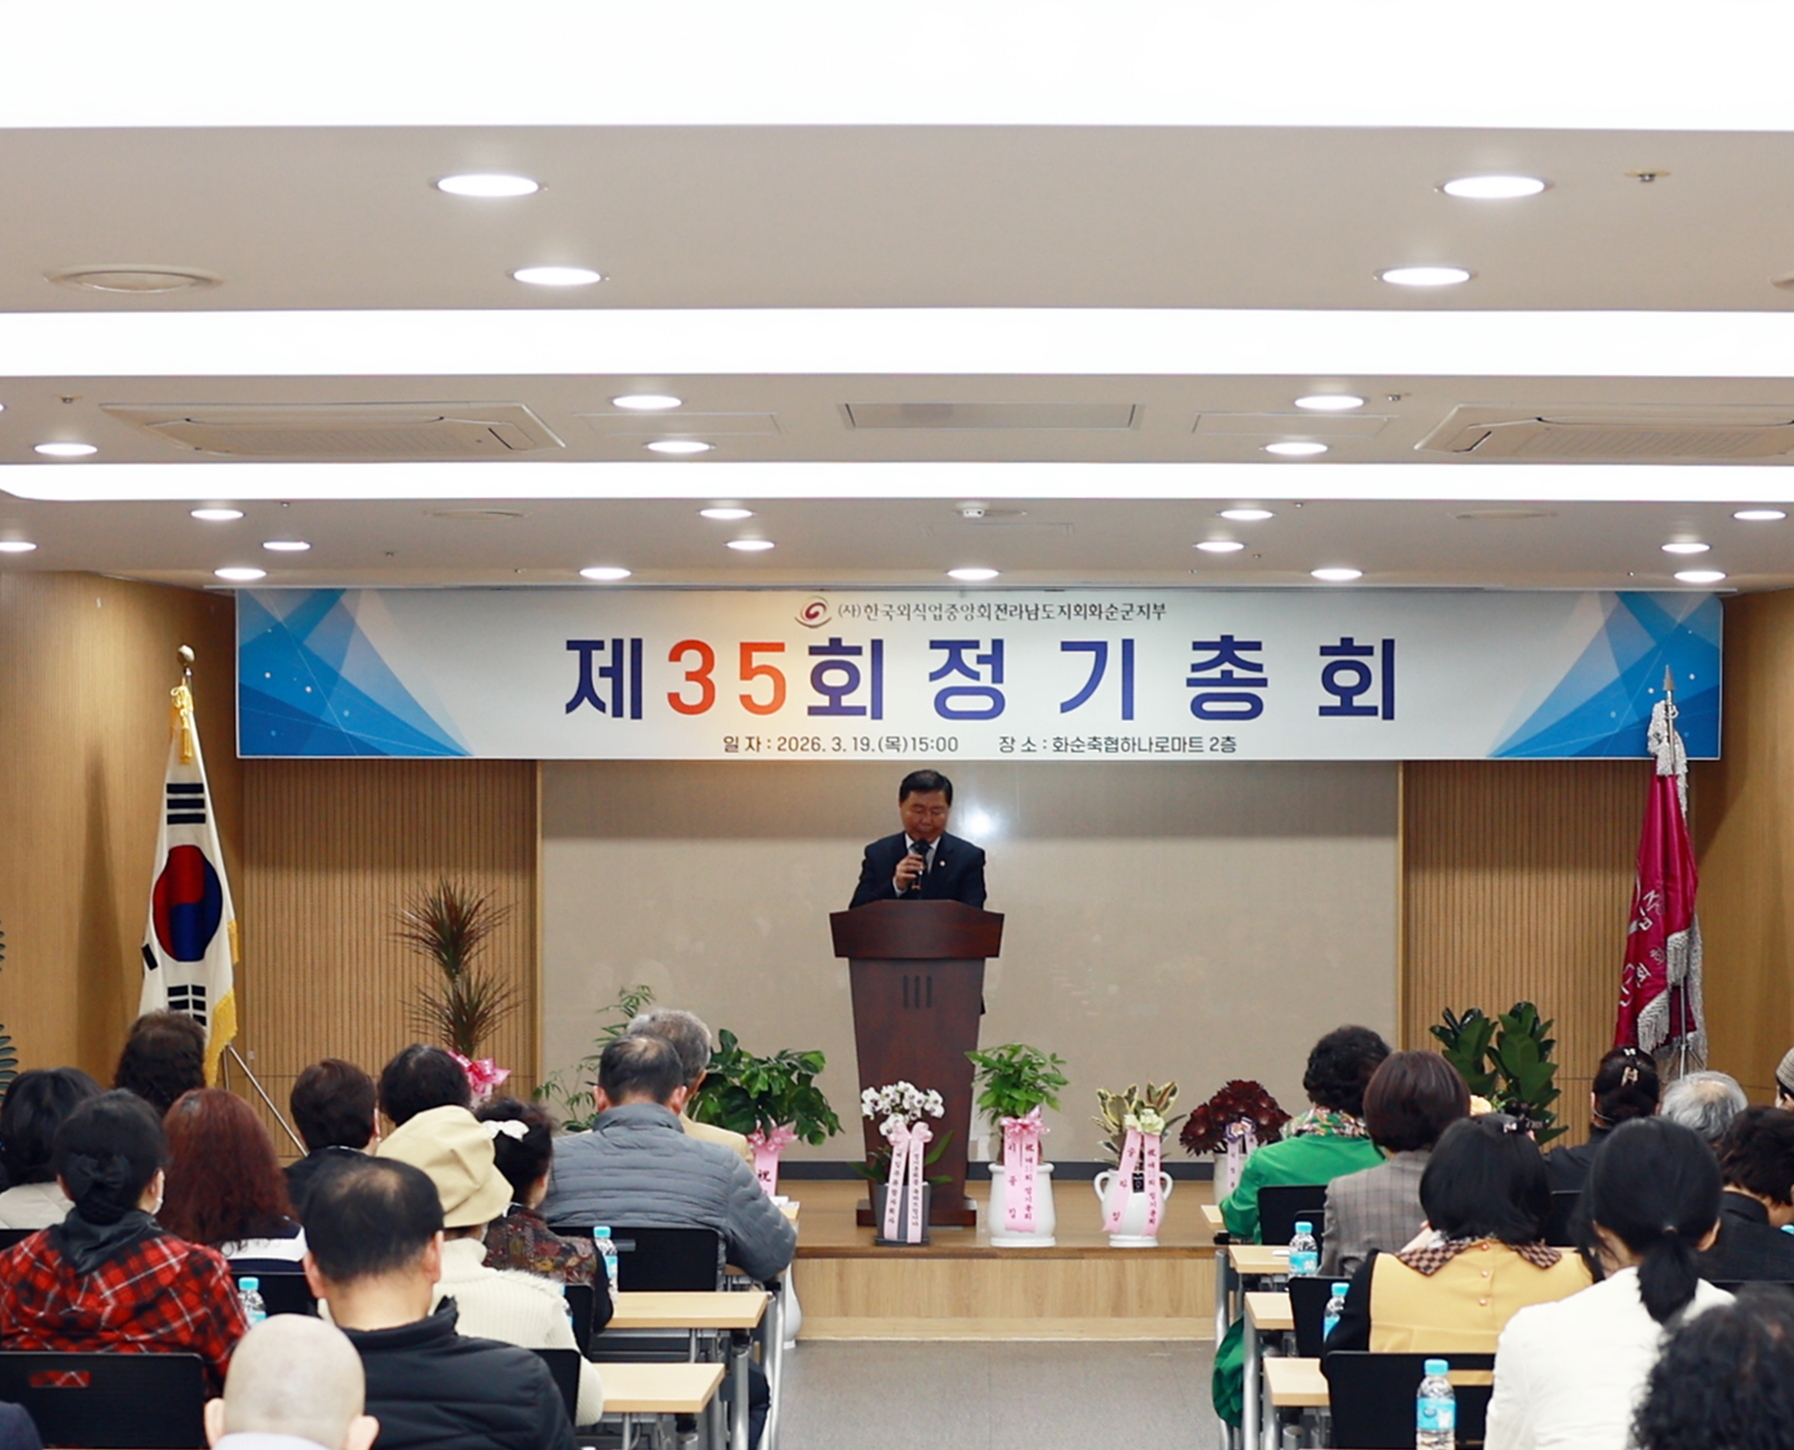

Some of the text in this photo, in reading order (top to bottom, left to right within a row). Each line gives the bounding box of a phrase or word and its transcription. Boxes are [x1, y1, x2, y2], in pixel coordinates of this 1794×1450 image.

[565, 636, 884, 721] 제35회
[1052, 736, 1204, 753] 화순축협하나로마트
[1209, 736, 1237, 753] 2층
